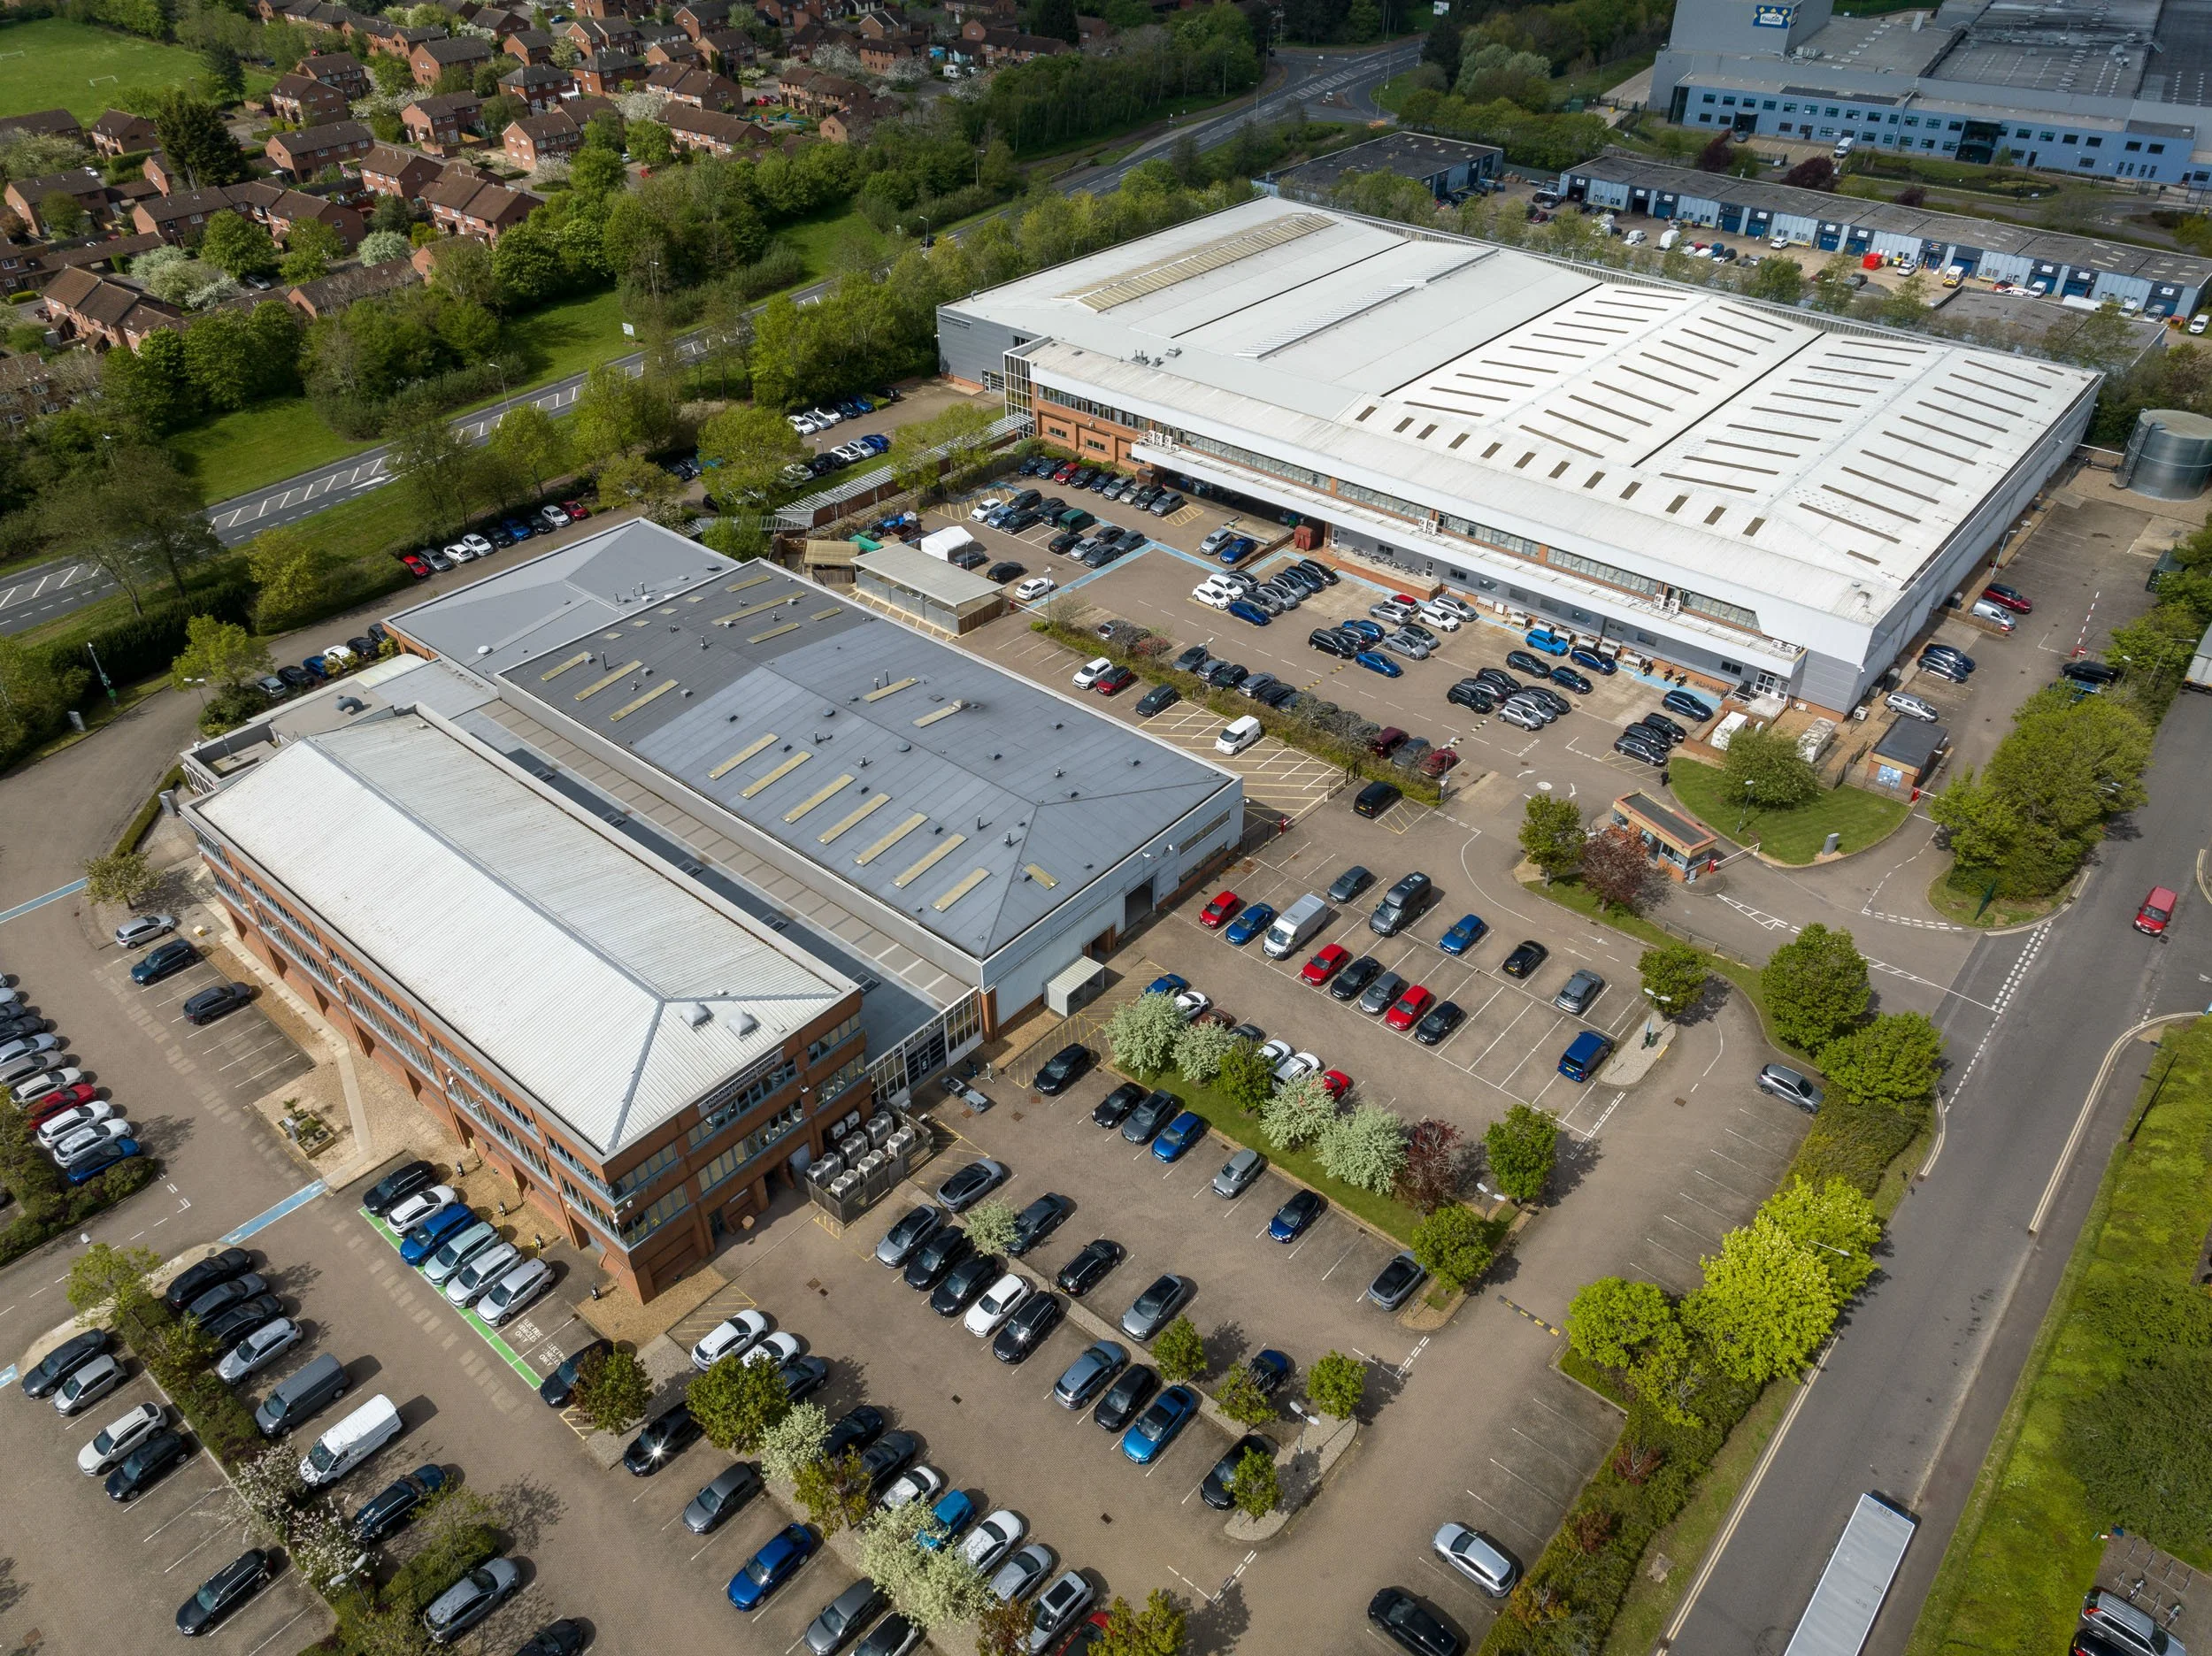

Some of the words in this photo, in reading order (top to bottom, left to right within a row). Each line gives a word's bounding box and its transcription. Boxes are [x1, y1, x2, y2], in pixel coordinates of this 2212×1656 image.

[708, 1092, 730, 1109] National
[733, 1073, 757, 1094] Learning
[518, 1323, 537, 1343] VEHICLES
[522, 1318, 543, 1338] ELECTRIC
